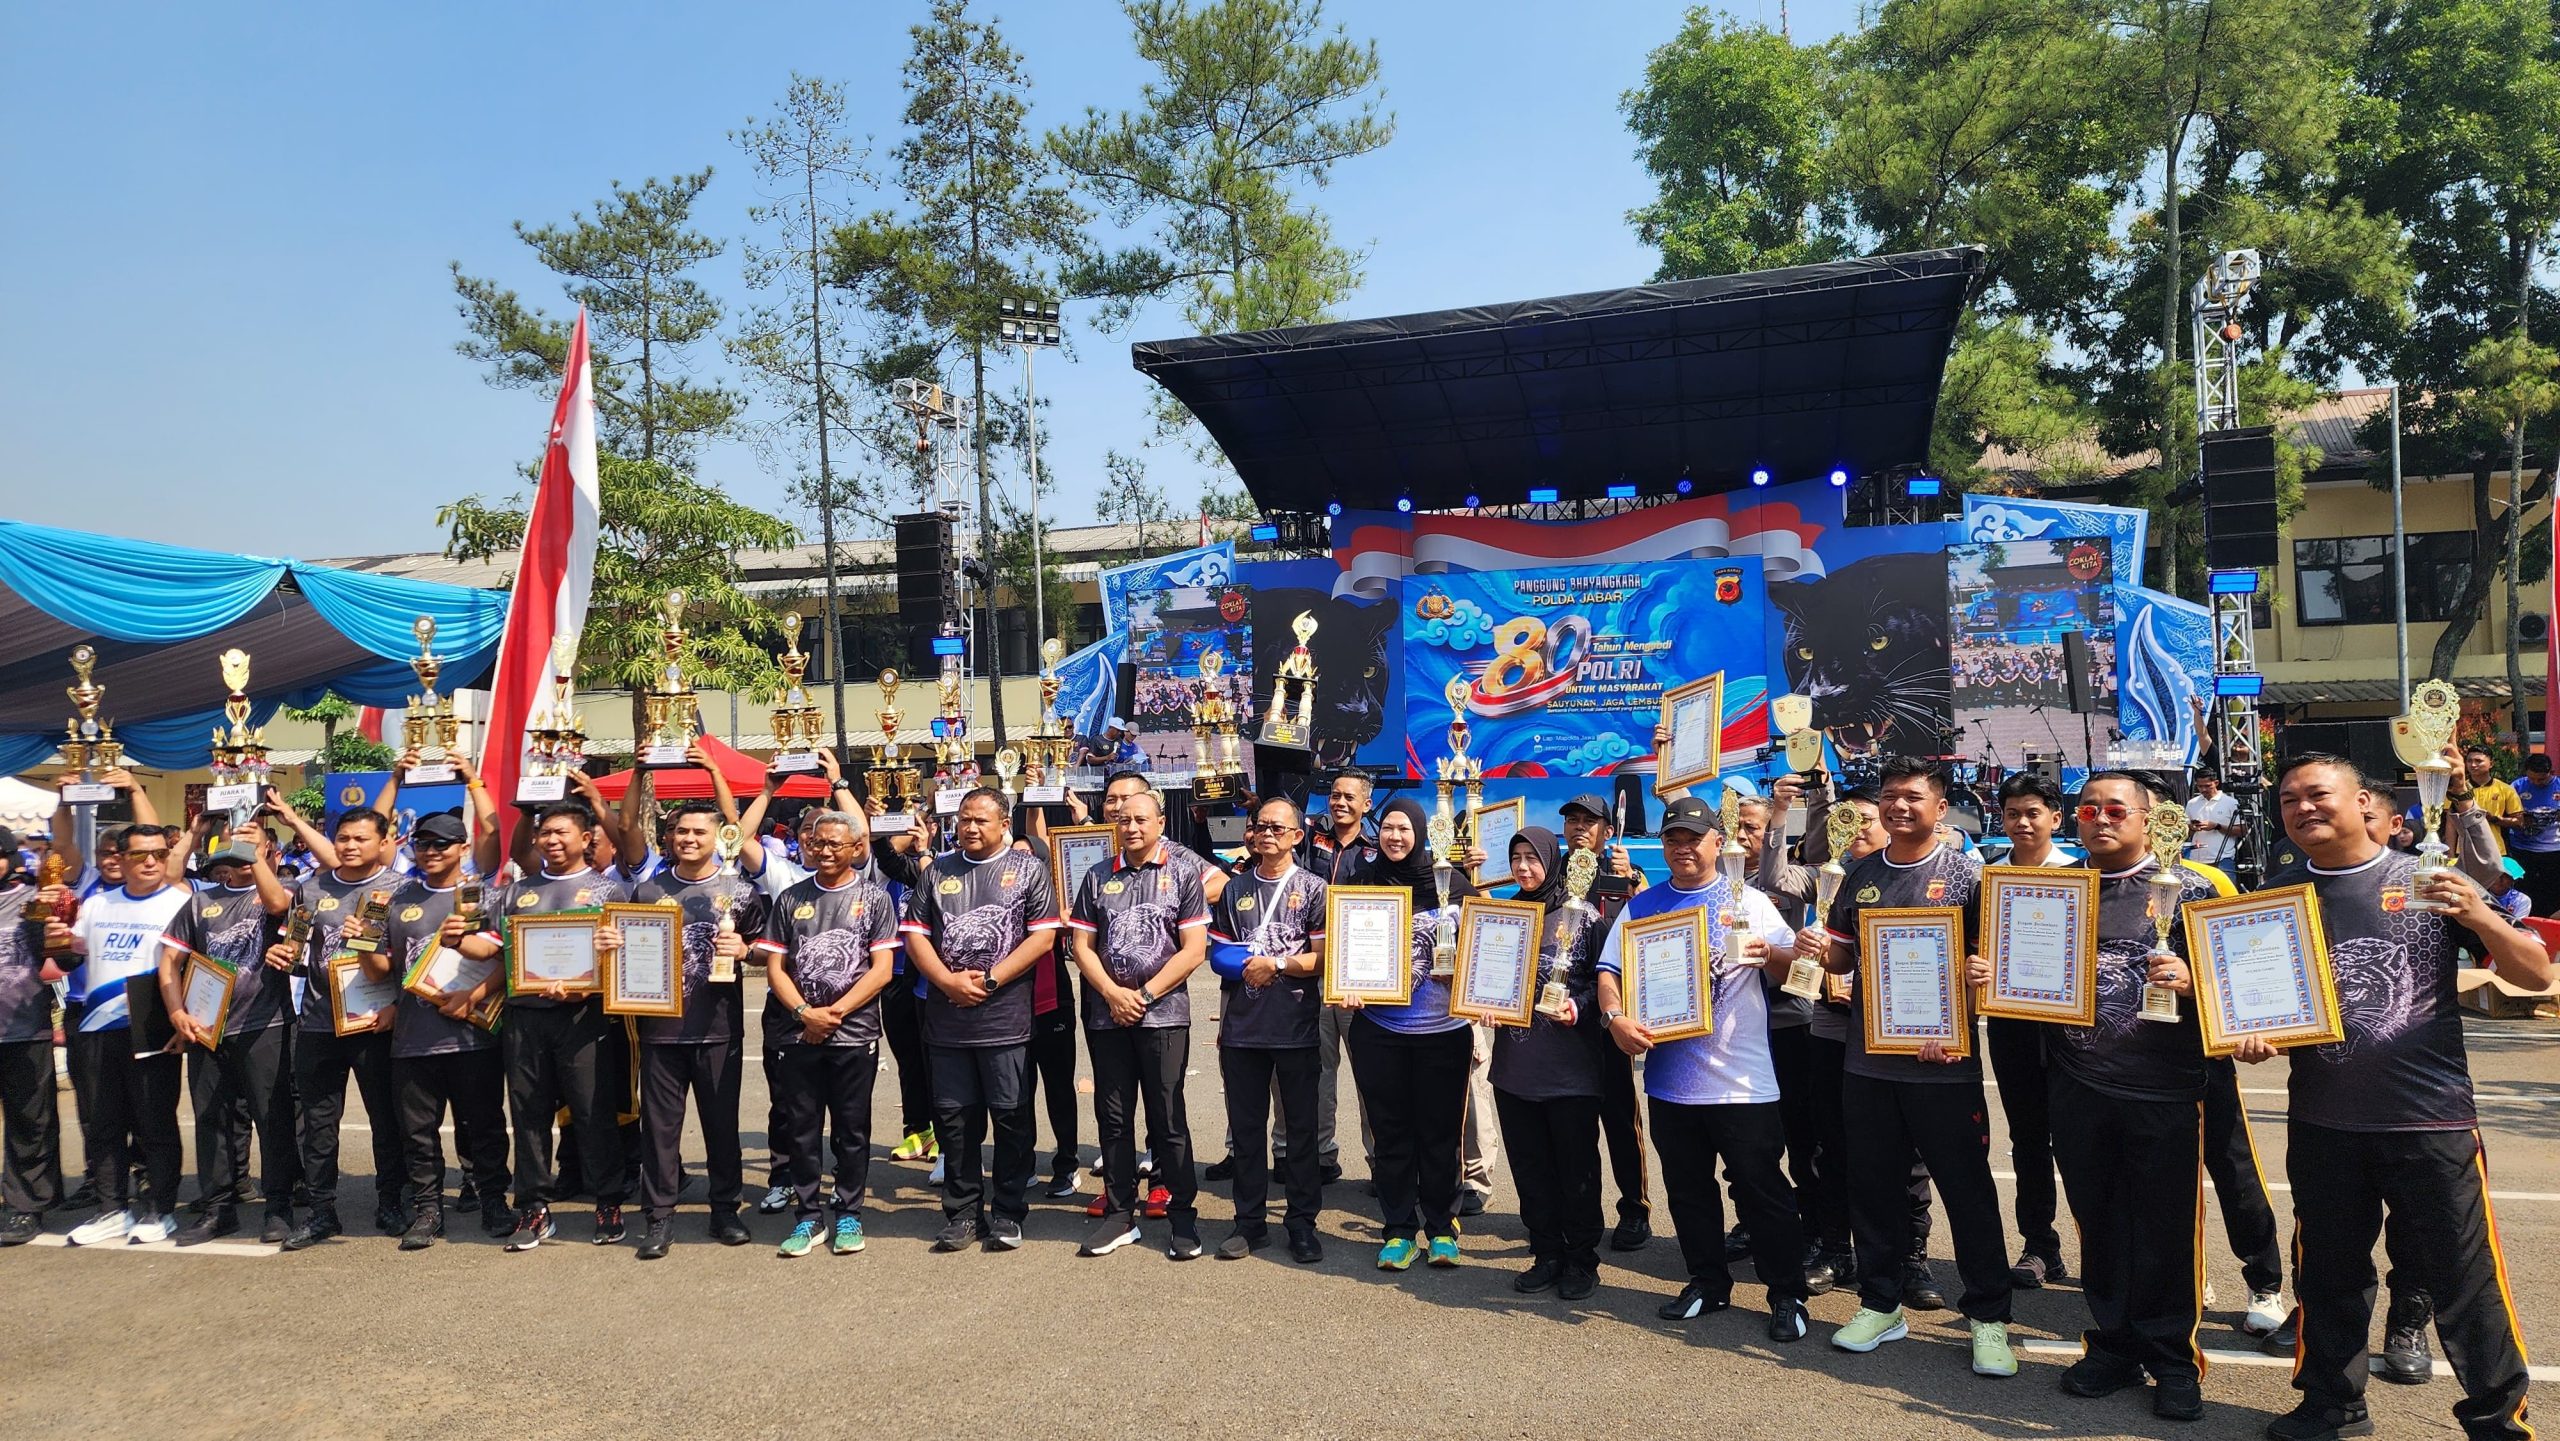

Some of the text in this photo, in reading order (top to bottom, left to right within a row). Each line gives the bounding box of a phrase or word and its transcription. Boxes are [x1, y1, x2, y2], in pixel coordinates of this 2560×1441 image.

[2069, 552, 2098, 566] COKLAT
[2081, 561, 2098, 570] KITA
[1514, 574, 1640, 593] PANGGUNG BHAYANGKARA
[1221, 598, 1243, 610] COKLAT
[1532, 591, 1623, 606] POLDA JABAR
[1230, 605, 1242, 613] KITA
[1593, 640, 1672, 652] Tahun Mengabdi
[1481, 615, 1592, 697] 80
[1576, 660, 1641, 682] POLRI
[1565, 682, 1664, 694] UNTUK MASYARAKAT
[1601, 698, 1625, 706] JAGA
[104, 932, 144, 949] RUN
[101, 951, 133, 961] 2026
